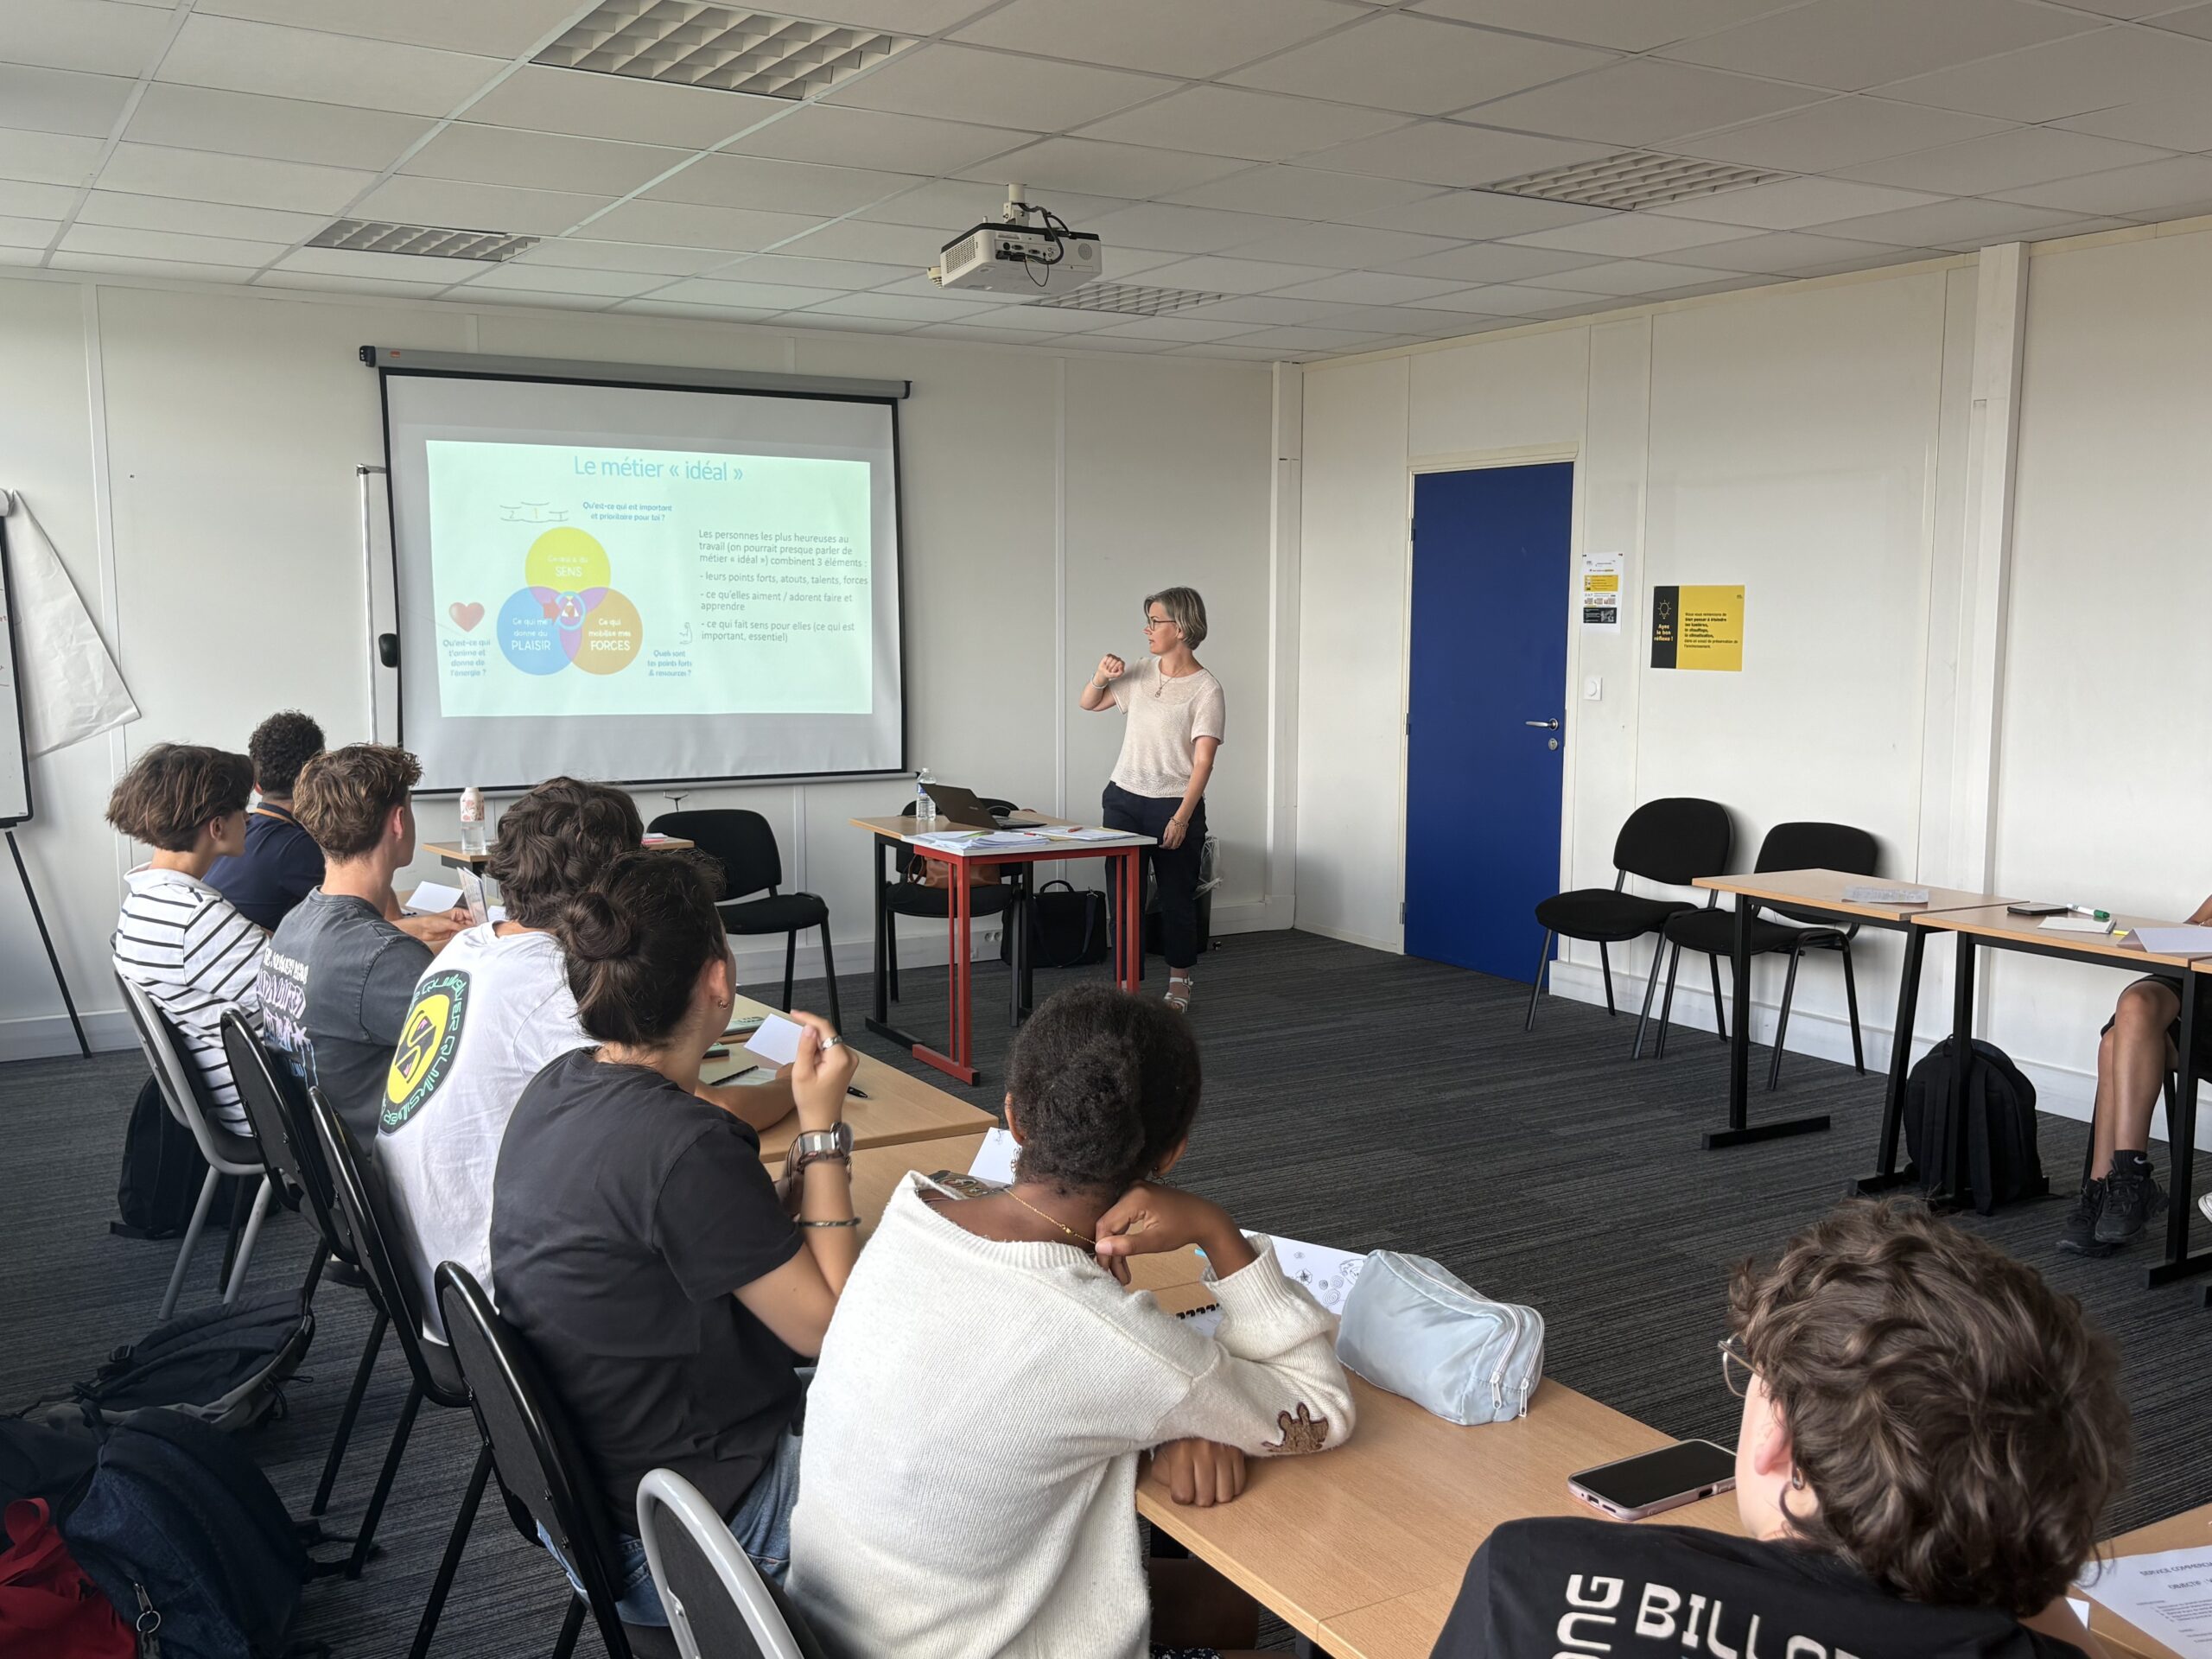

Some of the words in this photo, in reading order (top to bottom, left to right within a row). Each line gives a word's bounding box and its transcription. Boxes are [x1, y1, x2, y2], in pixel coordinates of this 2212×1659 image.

[574, 455, 596, 475] Le
[601, 456, 664, 478] métier
[669, 465, 679, 477] «
[685, 461, 728, 480] idéal
[734, 468, 743, 480] »
[582, 501, 615, 511] Qu'est-ce
[616, 503, 627, 512] qui
[699, 530, 713, 538] Les
[715, 531, 759, 541] personnes
[761, 531, 772, 541] les
[775, 532, 792, 543] plus
[794, 533, 836, 543] heureuses
[699, 542, 725, 550] travail
[727, 543, 741, 553] (on
[743, 543, 778, 554] pourrait
[779, 546, 813, 556] presque
[816, 546, 839, 556] parler
[700, 554, 727, 563] métier
[737, 555, 758, 563] idéal
[770, 557, 815, 566] combinent
[824, 557, 862, 567] éléments
[555, 567, 582, 577] SENS
[705, 571, 727, 581] leurs
[728, 573, 754, 583] points
[757, 574, 779, 583] forts,
[780, 575, 809, 585] atouts,
[811, 575, 842, 585] talents,
[843, 576, 868, 585] forces
[719, 591, 750, 601] qu'elles
[783, 592, 788, 601] /
[790, 593, 822, 601] adorent
[824, 593, 842, 602] faire
[701, 601, 746, 612] apprendre
[524, 618, 535, 626] qui
[610, 619, 620, 627] qui
[719, 620, 733, 631] qui
[734, 620, 748, 629] fait
[771, 622, 791, 632] pour
[792, 621, 811, 631] elles
[813, 622, 825, 632] (ce
[828, 622, 841, 632] qui
[702, 632, 746, 642] important,
[748, 632, 788, 642] essentiel)
[479, 639, 491, 648] qui
[512, 640, 551, 650] PLAISIR
[591, 640, 631, 651] FORCES
